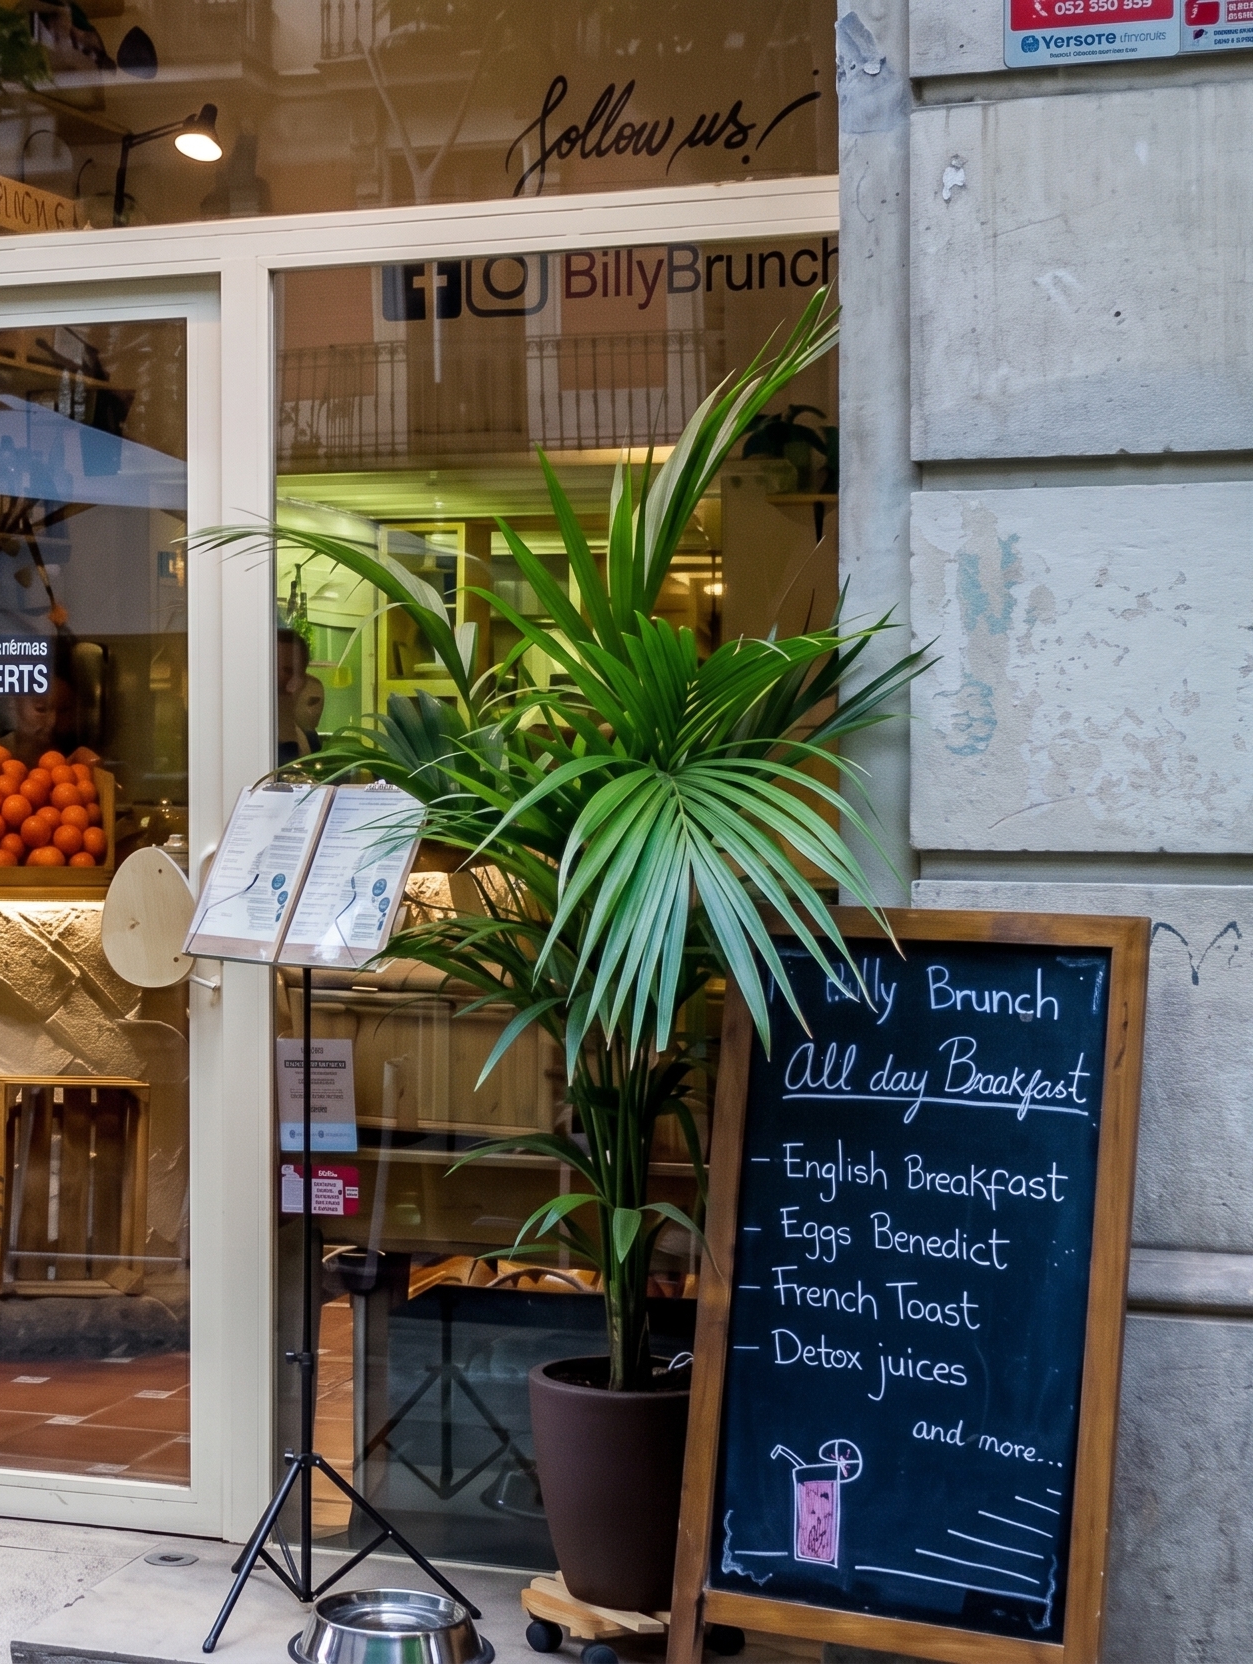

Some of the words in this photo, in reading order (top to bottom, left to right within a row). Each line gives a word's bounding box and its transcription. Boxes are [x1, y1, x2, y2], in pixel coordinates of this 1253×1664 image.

[1054, 1, 1084, 15] 052
[926, 965, 1059, 1021] Brunch
[785, 1042, 857, 1091] All
[869, 1053, 929, 1124] day
[782, 1139, 888, 1203] English
[904, 1154, 1069, 1211] Breakfast
[779, 1206, 852, 1263] Eggs
[869, 1211, 1011, 1270] Benedict
[771, 1265, 878, 1320] French
[885, 1281, 981, 1330] Toast
[771, 1328, 863, 1371] Detox
[867, 1342, 968, 1401] juices
[912, 1419, 965, 1447] and
